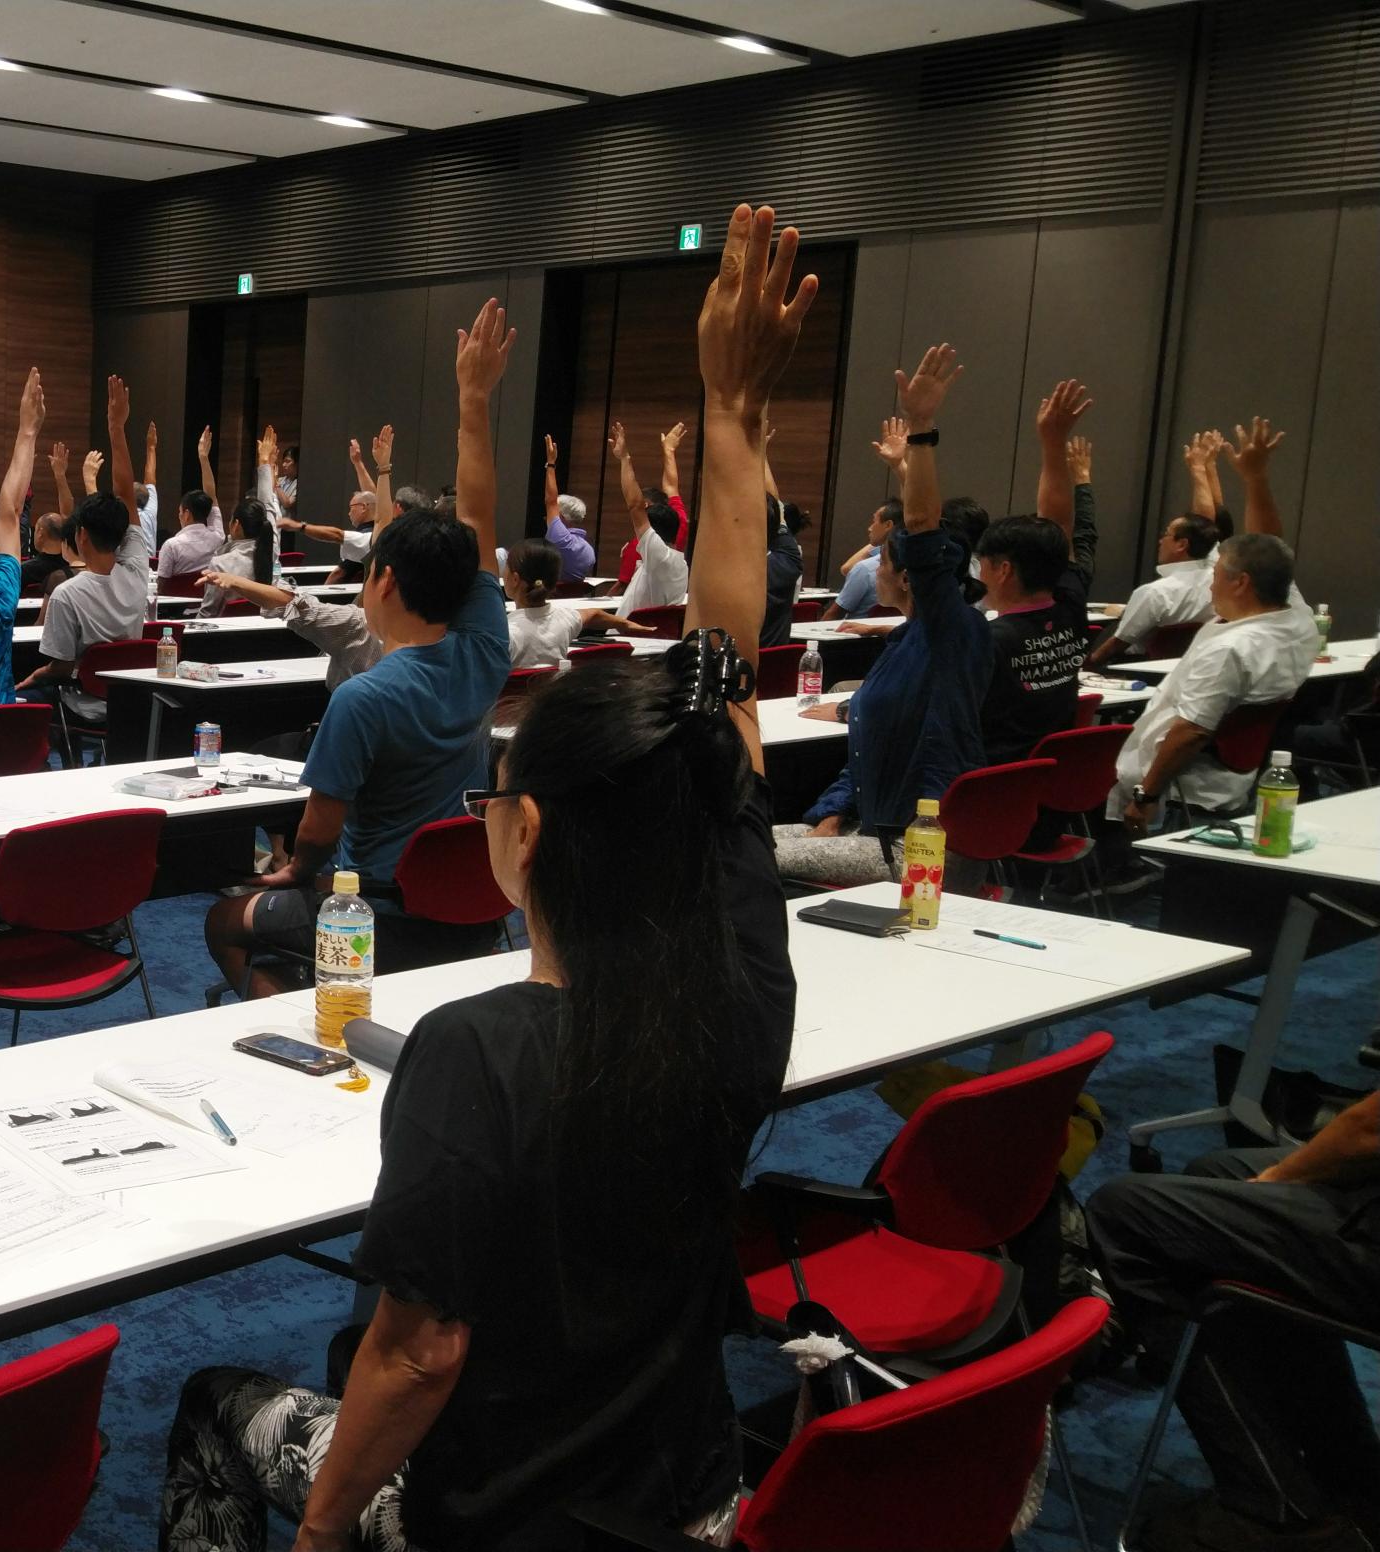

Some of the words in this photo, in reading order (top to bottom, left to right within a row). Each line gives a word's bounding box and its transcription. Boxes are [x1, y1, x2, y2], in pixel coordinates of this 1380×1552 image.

[1025, 628, 1074, 651] SHONAN
[1011, 637, 1089, 668] INTERNATIONA
[317, 942, 349, 966] 麦茶
